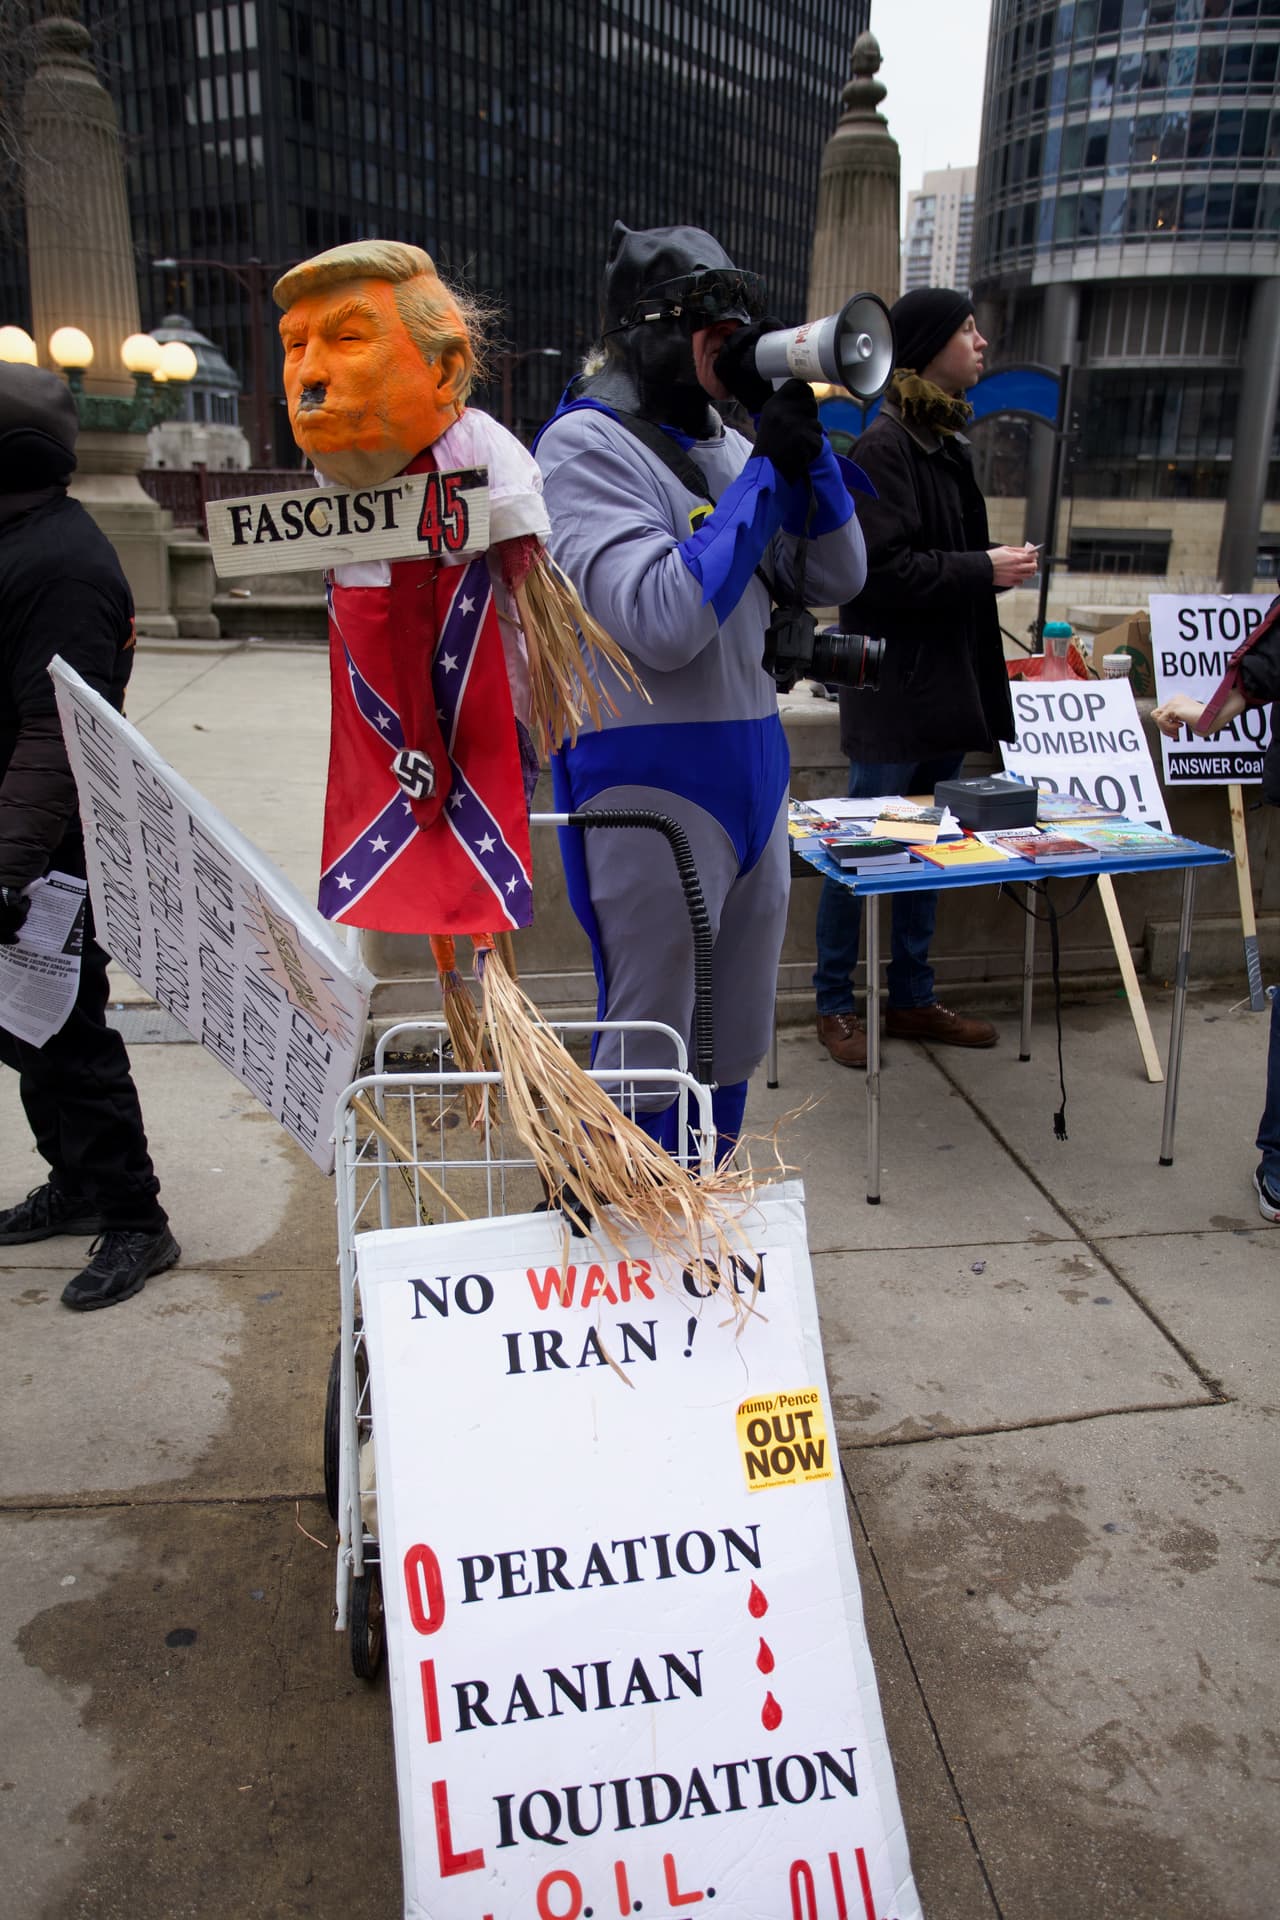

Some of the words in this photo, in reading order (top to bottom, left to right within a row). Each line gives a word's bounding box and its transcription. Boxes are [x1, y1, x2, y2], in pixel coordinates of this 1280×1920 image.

[227, 488, 402, 545] FASCIST
[418, 472, 470, 556] 45
[1178, 608, 1262, 641] STOP
[1015, 692, 1106, 723] STOP
[69, 692, 121, 798] WITH
[1006, 729, 1140, 754] BOMBING
[1169, 758, 1231, 775] ANSWER
[132, 760, 184, 944] THREATENING
[189, 814, 234, 912] CAN'T
[101, 861, 142, 978] GADZOOKS,
[196, 885, 235, 949] WE
[154, 927, 190, 1028] FASCISTS
[244, 964, 281, 1018] IN
[262, 905, 327, 1023] PROTEST!
[202, 1017, 235, 1069] THE
[243, 993, 277, 1061] STAY
[242, 1038, 274, 1107] JUST
[285, 1009, 333, 1123] BATCAVE!
[281, 1096, 317, 1152] THE
[408, 1274, 494, 1320] NO
[527, 1260, 655, 1310] WAR
[682, 1252, 767, 1298] ON
[502, 1320, 658, 1375] IRAN
[745, 1439, 824, 1480] NOW
[747, 1410, 813, 1447] OUT
